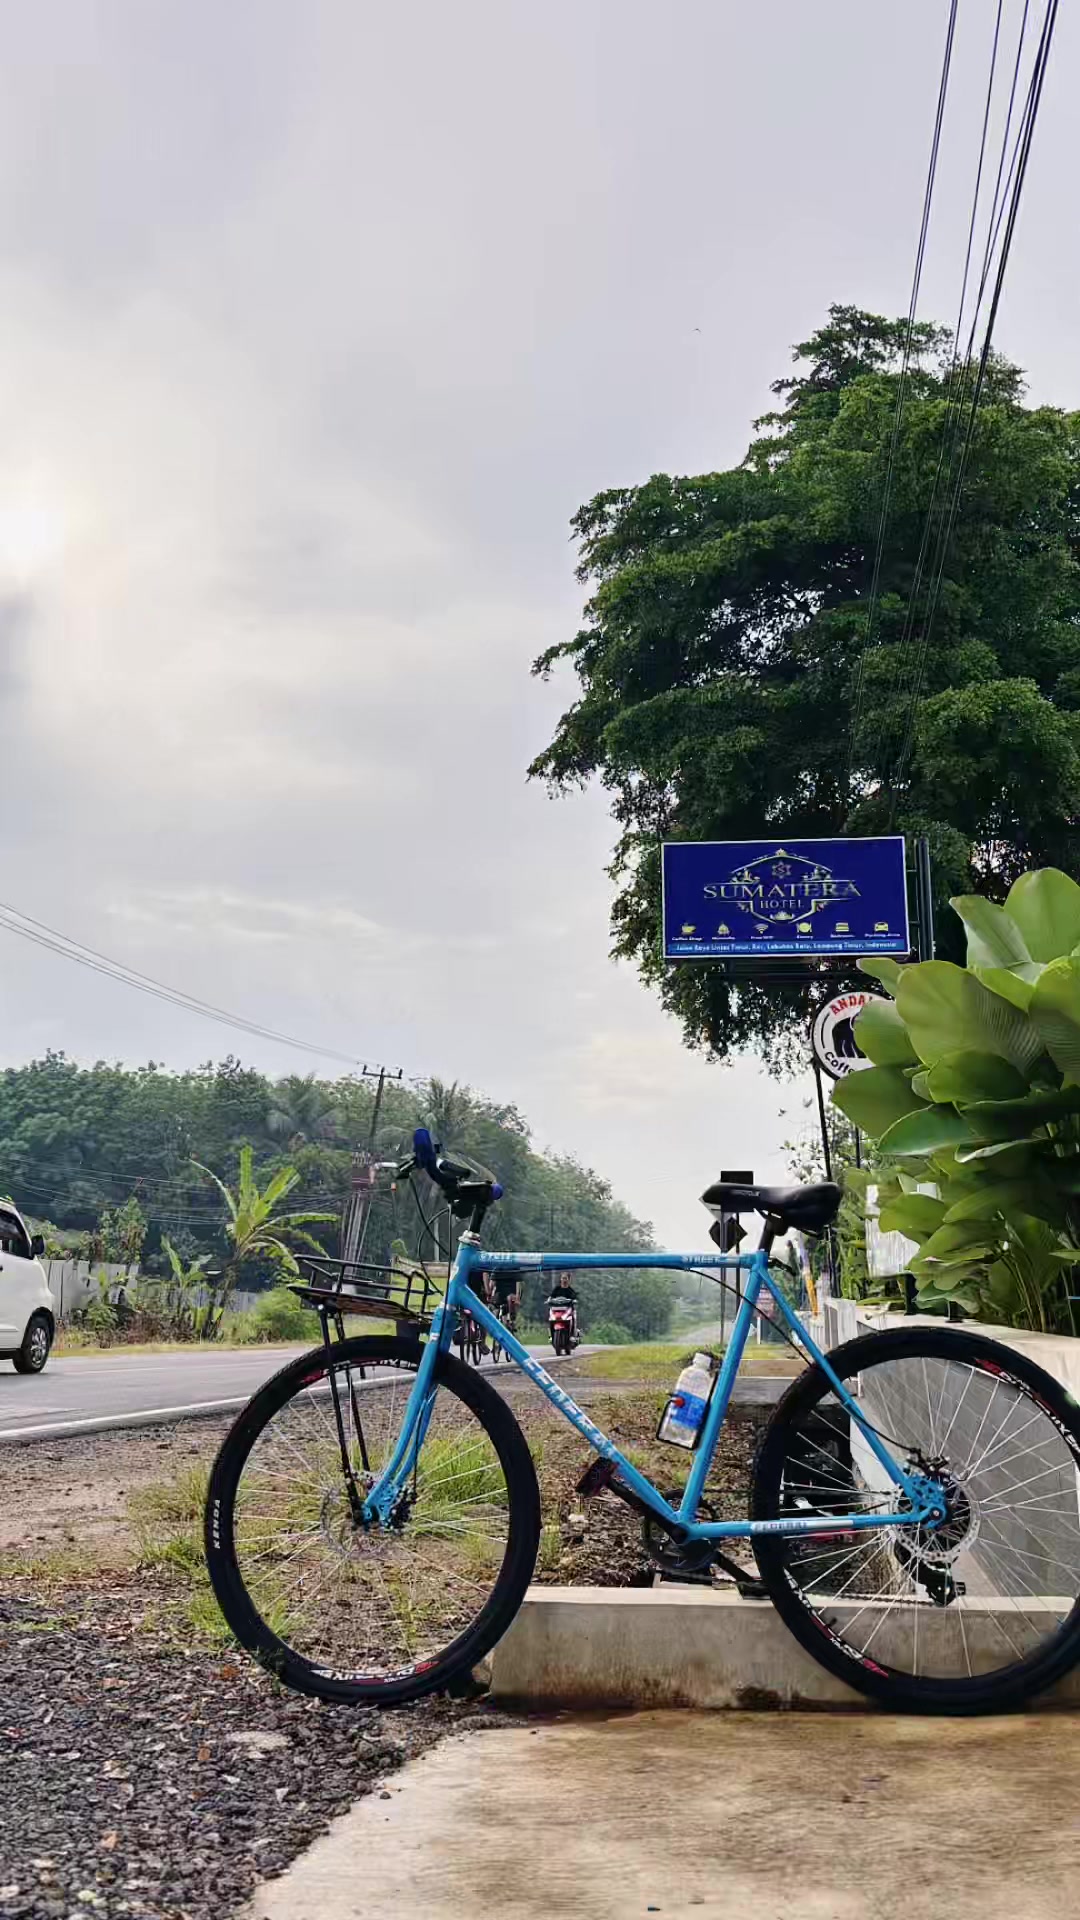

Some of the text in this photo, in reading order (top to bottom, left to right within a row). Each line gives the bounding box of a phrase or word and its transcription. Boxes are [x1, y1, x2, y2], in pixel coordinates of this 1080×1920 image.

[703, 882, 862, 899] SUMATERA
[760, 900, 804, 909] HOTEL
[212, 1499, 221, 1549] KENDA
